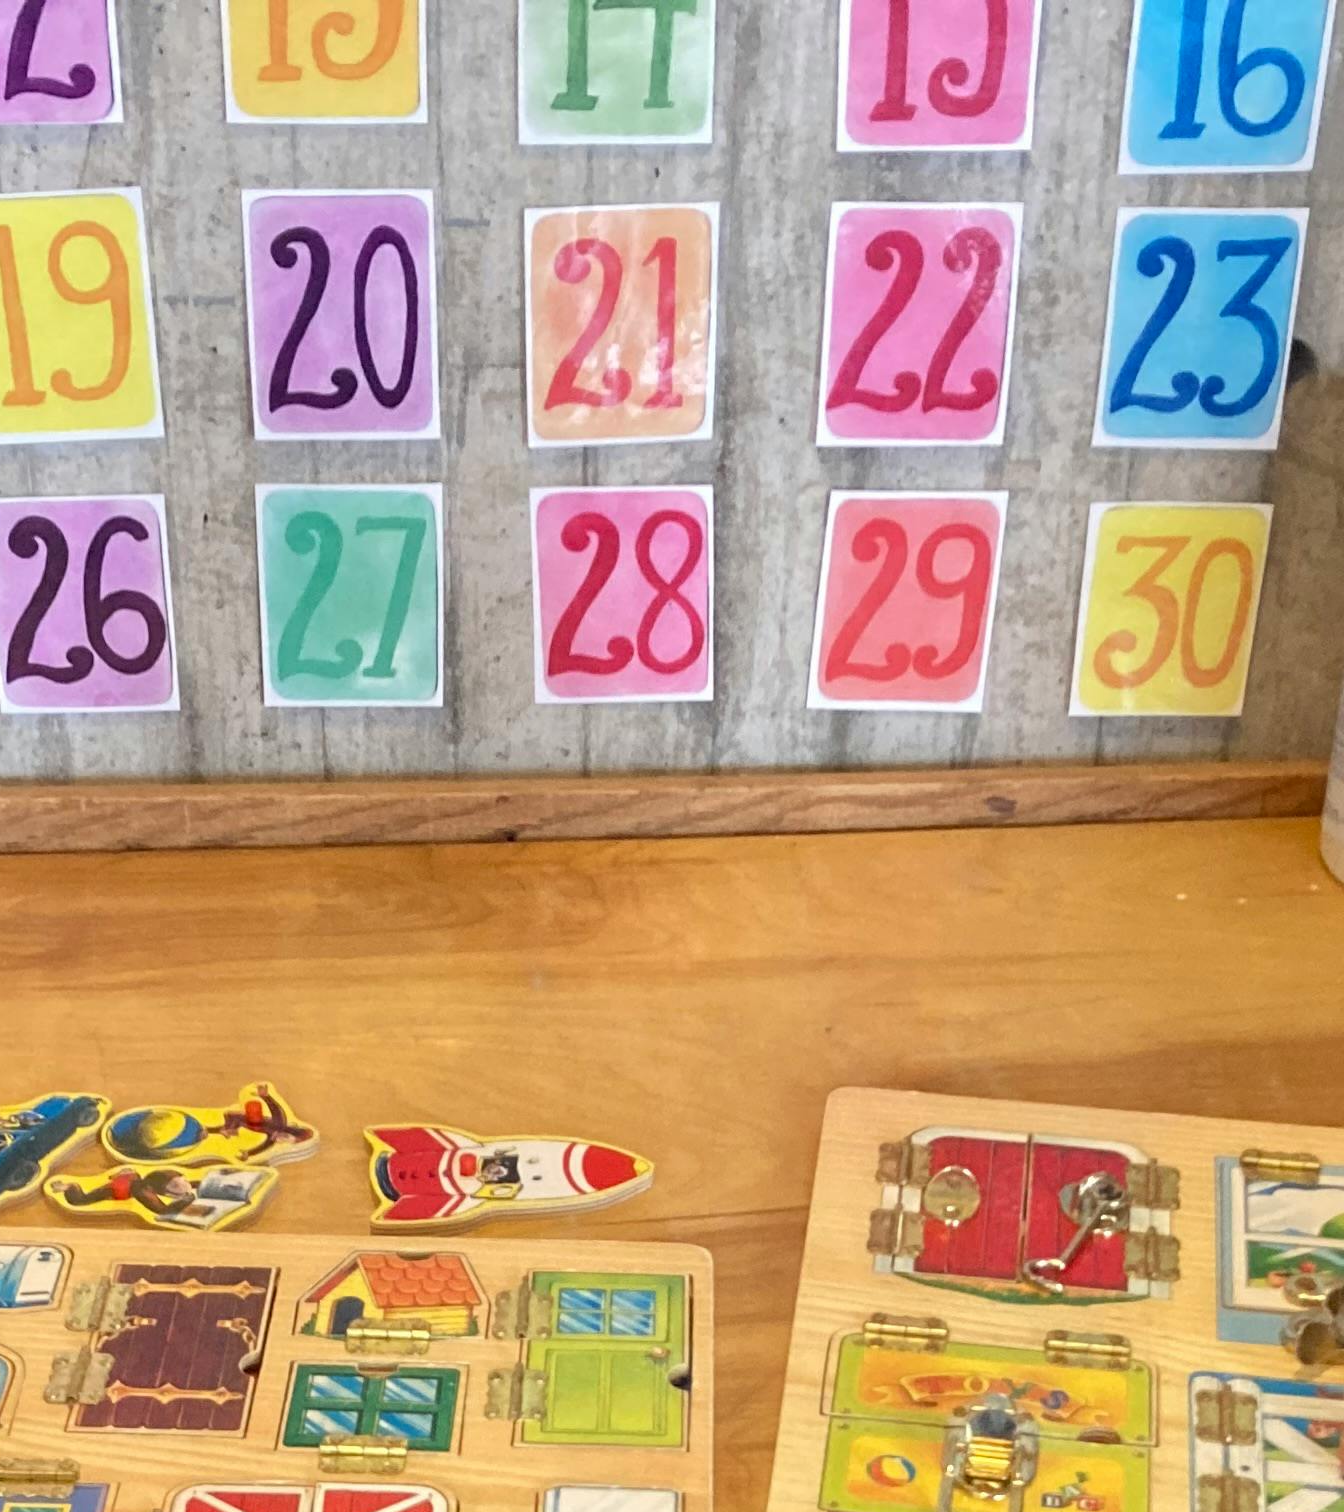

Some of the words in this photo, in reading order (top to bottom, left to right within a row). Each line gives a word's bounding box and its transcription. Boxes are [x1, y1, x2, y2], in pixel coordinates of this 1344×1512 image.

[1158, 0, 1306, 139] 16
[269, 225, 418, 413] 20
[543, 237, 683, 411] 21
[826, 227, 1002, 415] 22
[1109, 236, 1293, 417] 23
[6, 516, 166, 685] 26
[278, 510, 427, 682] 27
[547, 509, 704, 677] 28
[825, 517, 991, 683] 29
[1093, 535, 1254, 689] 30
